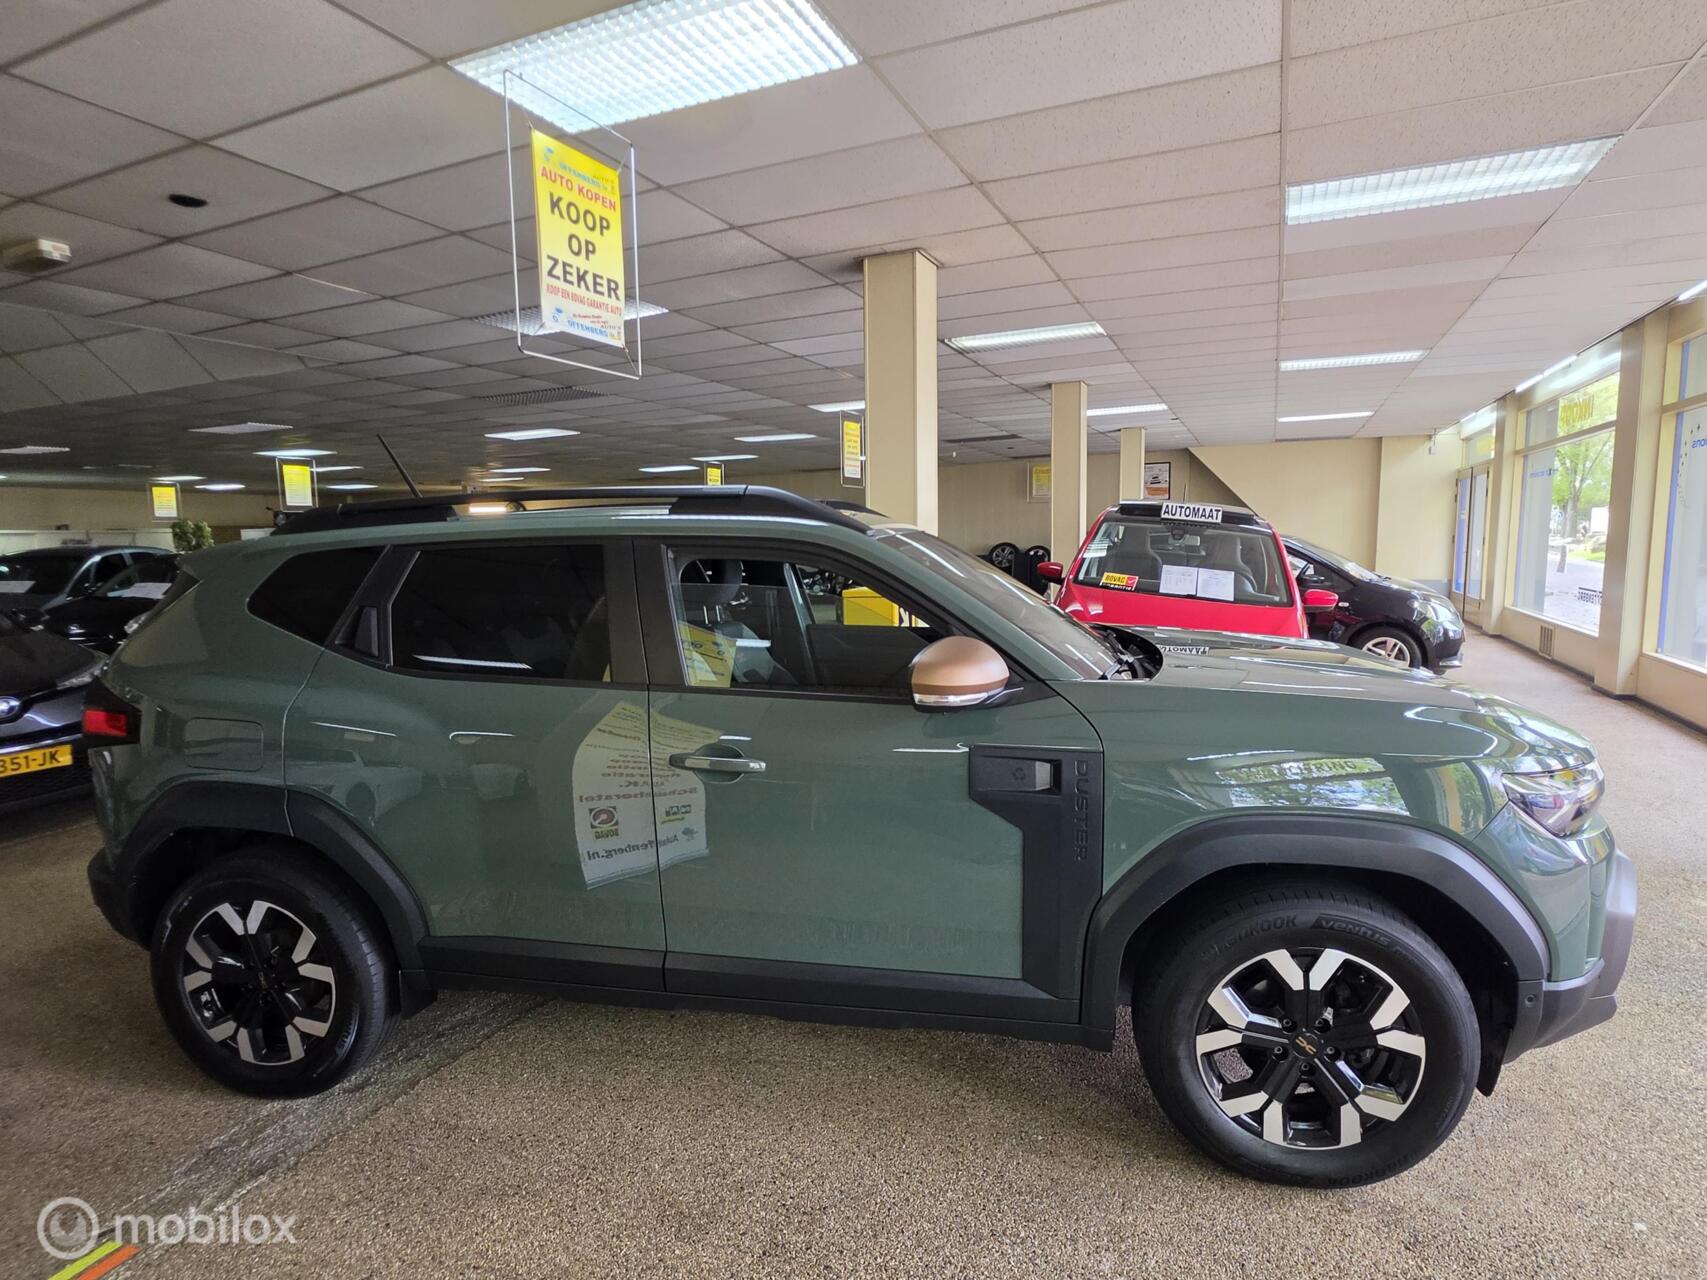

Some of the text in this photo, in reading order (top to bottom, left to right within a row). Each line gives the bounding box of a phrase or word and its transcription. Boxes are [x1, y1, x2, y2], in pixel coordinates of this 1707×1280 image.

[541, 165, 573, 192] AUTO
[577, 183, 616, 212] KOPEN
[549, 192, 610, 237] KOOP
[567, 233, 597, 261] OP
[546, 254, 621, 301] ZEKER
[547, 283, 560, 296] KOOP
[561, 288, 570, 300] EEN
[587, 297, 609, 312] GARANTIE
[1162, 504, 1221, 520] AUTOMAAT
[1104, 574, 1125, 584] BOVAG
[1074, 759, 1088, 861] DUSTER
